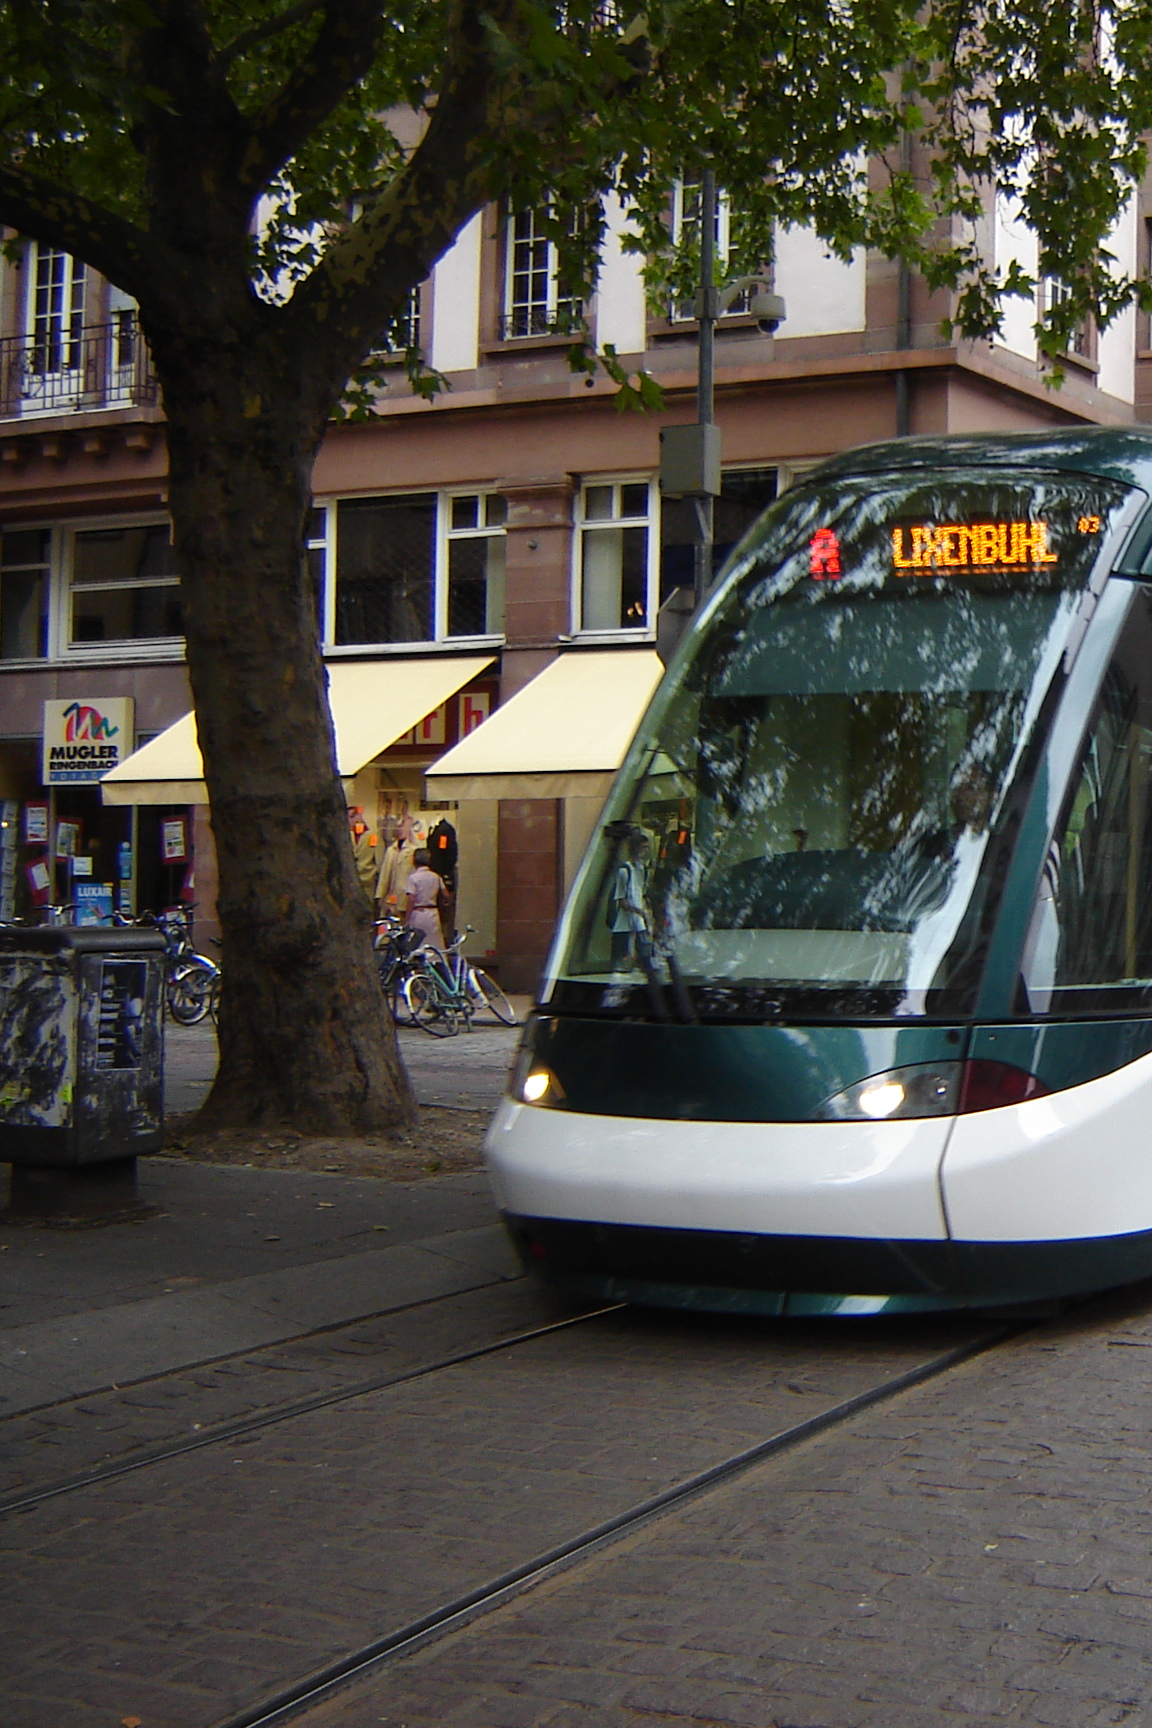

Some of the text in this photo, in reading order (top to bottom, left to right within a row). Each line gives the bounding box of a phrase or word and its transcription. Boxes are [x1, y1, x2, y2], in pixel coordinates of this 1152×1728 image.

[810, 528, 841, 575] A
[50, 745, 119, 760] MUGLER
[50, 772, 104, 780] VOYAG
[77, 886, 113, 897] LUXAIR
